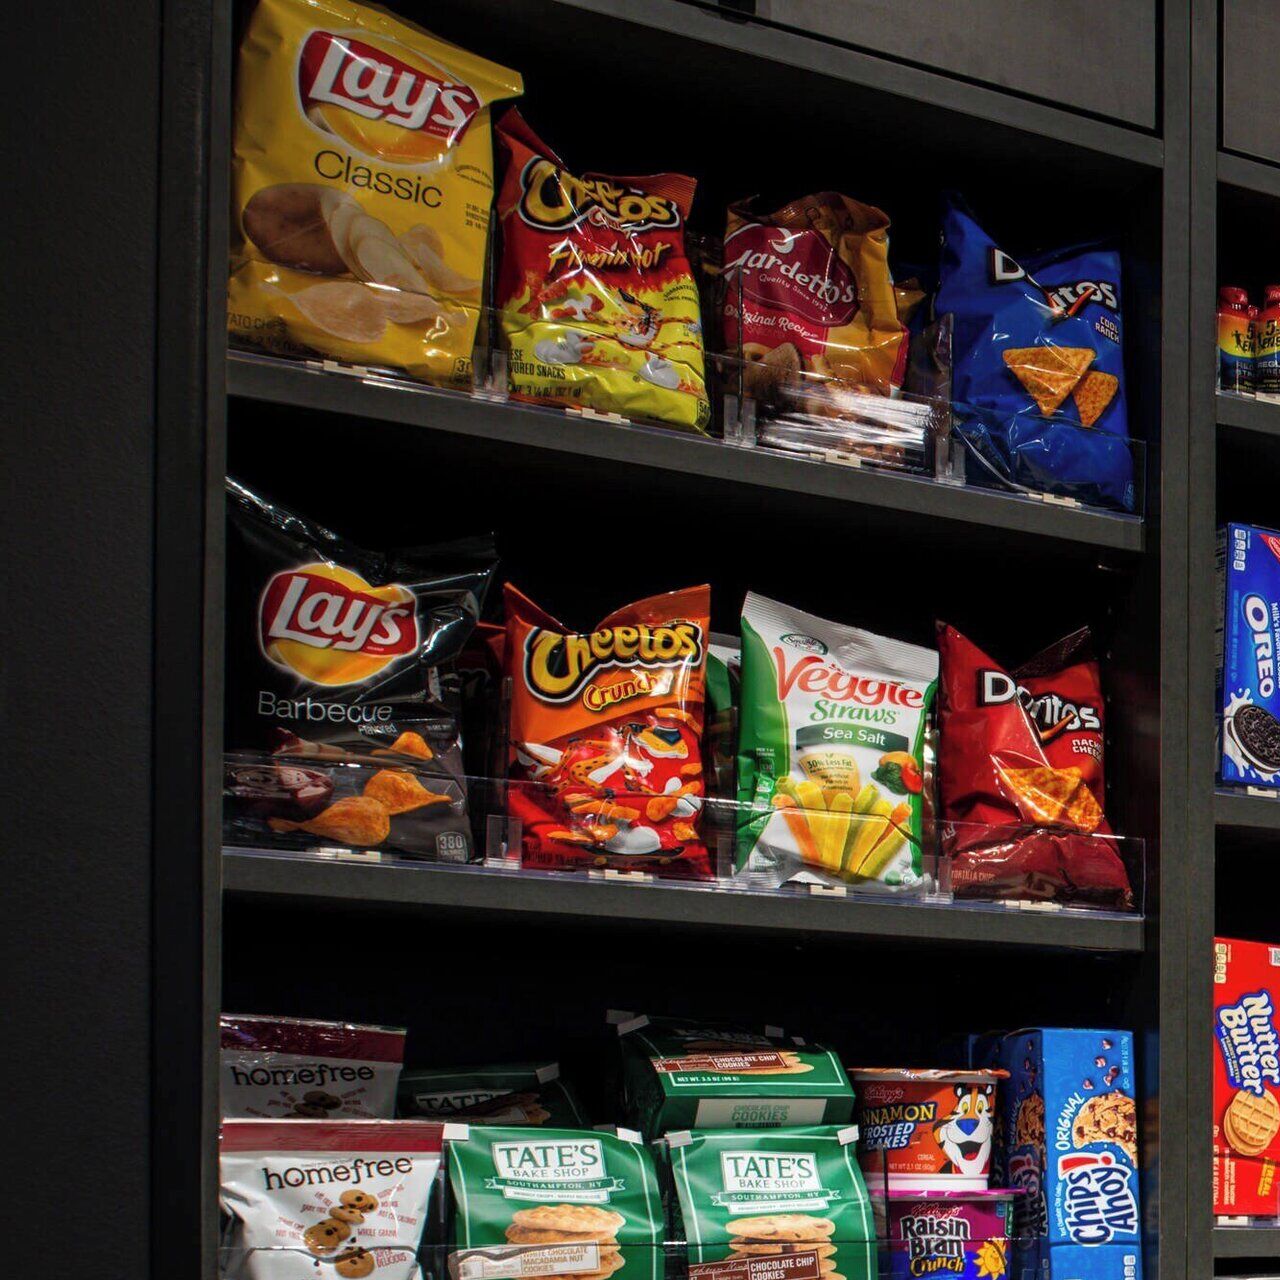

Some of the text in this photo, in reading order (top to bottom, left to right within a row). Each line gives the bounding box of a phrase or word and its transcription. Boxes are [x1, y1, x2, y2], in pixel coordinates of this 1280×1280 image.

[308, 36, 473, 131] Lay's
[314, 150, 443, 208] Classic
[1095, 322, 1121, 344] RANCH
[1100, 316, 1119, 333] COOL
[536, 366, 566, 380] SNACKS
[269, 576, 410, 652] Lay's
[1244, 595, 1275, 698] OREO
[531, 624, 698, 695] Cheetos
[773, 645, 926, 710] Veggie
[258, 691, 392, 724] Barbecue
[809, 699, 899, 725] Straws
[983, 671, 1100, 731] Doritos
[357, 723, 398, 736] Flavored
[822, 726, 886, 747] Sea Salt
[438, 835, 463, 849] 380
[1219, 1005, 1262, 1096] Butter
[1243, 992, 1280, 1085] Nutter
[713, 1054, 777, 1064] CHOCOLATE CHIP
[231, 1064, 375, 1087] homefree
[731, 1110, 789, 1121] COOKIES
[1055, 1091, 1086, 1151] ORIGINAL
[498, 1144, 599, 1169] TATE'S
[726, 1155, 813, 1179] TATE'S
[261, 1157, 413, 1191] homefree
[513, 1167, 590, 1178] BAKE SHOP
[739, 1179, 806, 1189] BAKE SHOP
[588, 1181, 602, 1189] NY
[731, 1191, 820, 1201] SOUTHAMPTON, NY
[1067, 1167, 1111, 1245] Chips
[900, 1215, 971, 1240] Raisin
[908, 1234, 964, 1260] Bran
[522, 1254, 584, 1266] MACADAMIA NUT
[523, 1263, 555, 1273] COOKIES
[750, 1257, 815, 1272] CHOCOLATE CHIP
[909, 1255, 965, 1278] Crunch
